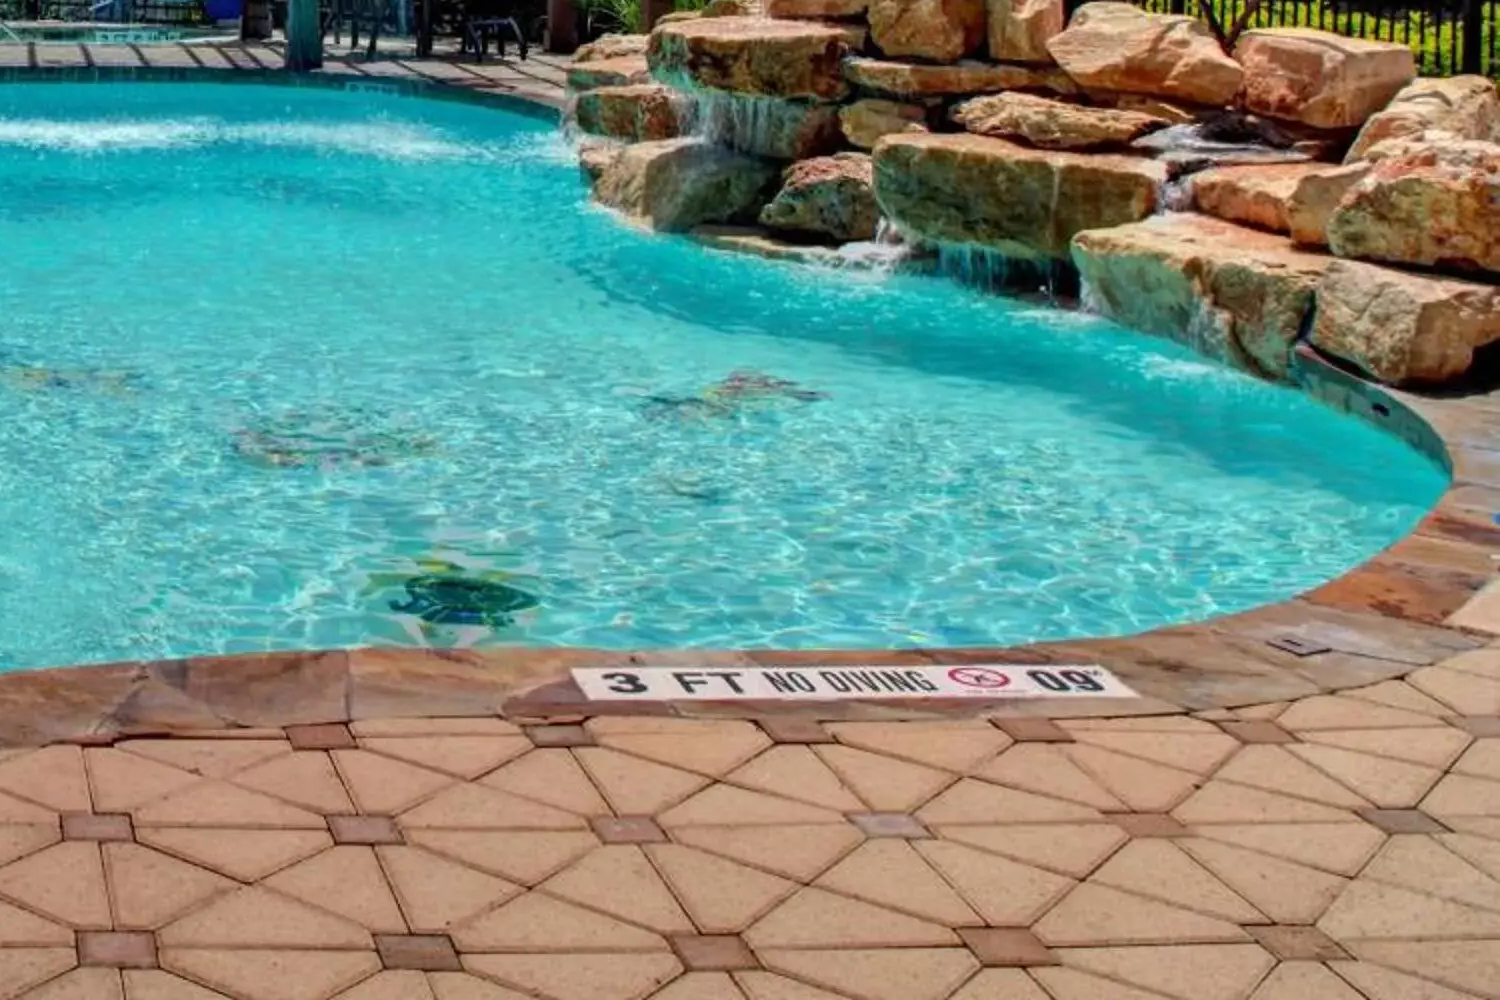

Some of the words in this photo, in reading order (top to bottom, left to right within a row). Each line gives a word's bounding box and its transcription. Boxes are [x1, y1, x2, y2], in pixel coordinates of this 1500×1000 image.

[601, 672, 648, 693] 3
[671, 671, 743, 694] FT
[761, 671, 817, 693] NO
[818, 670, 939, 692] DIVING
